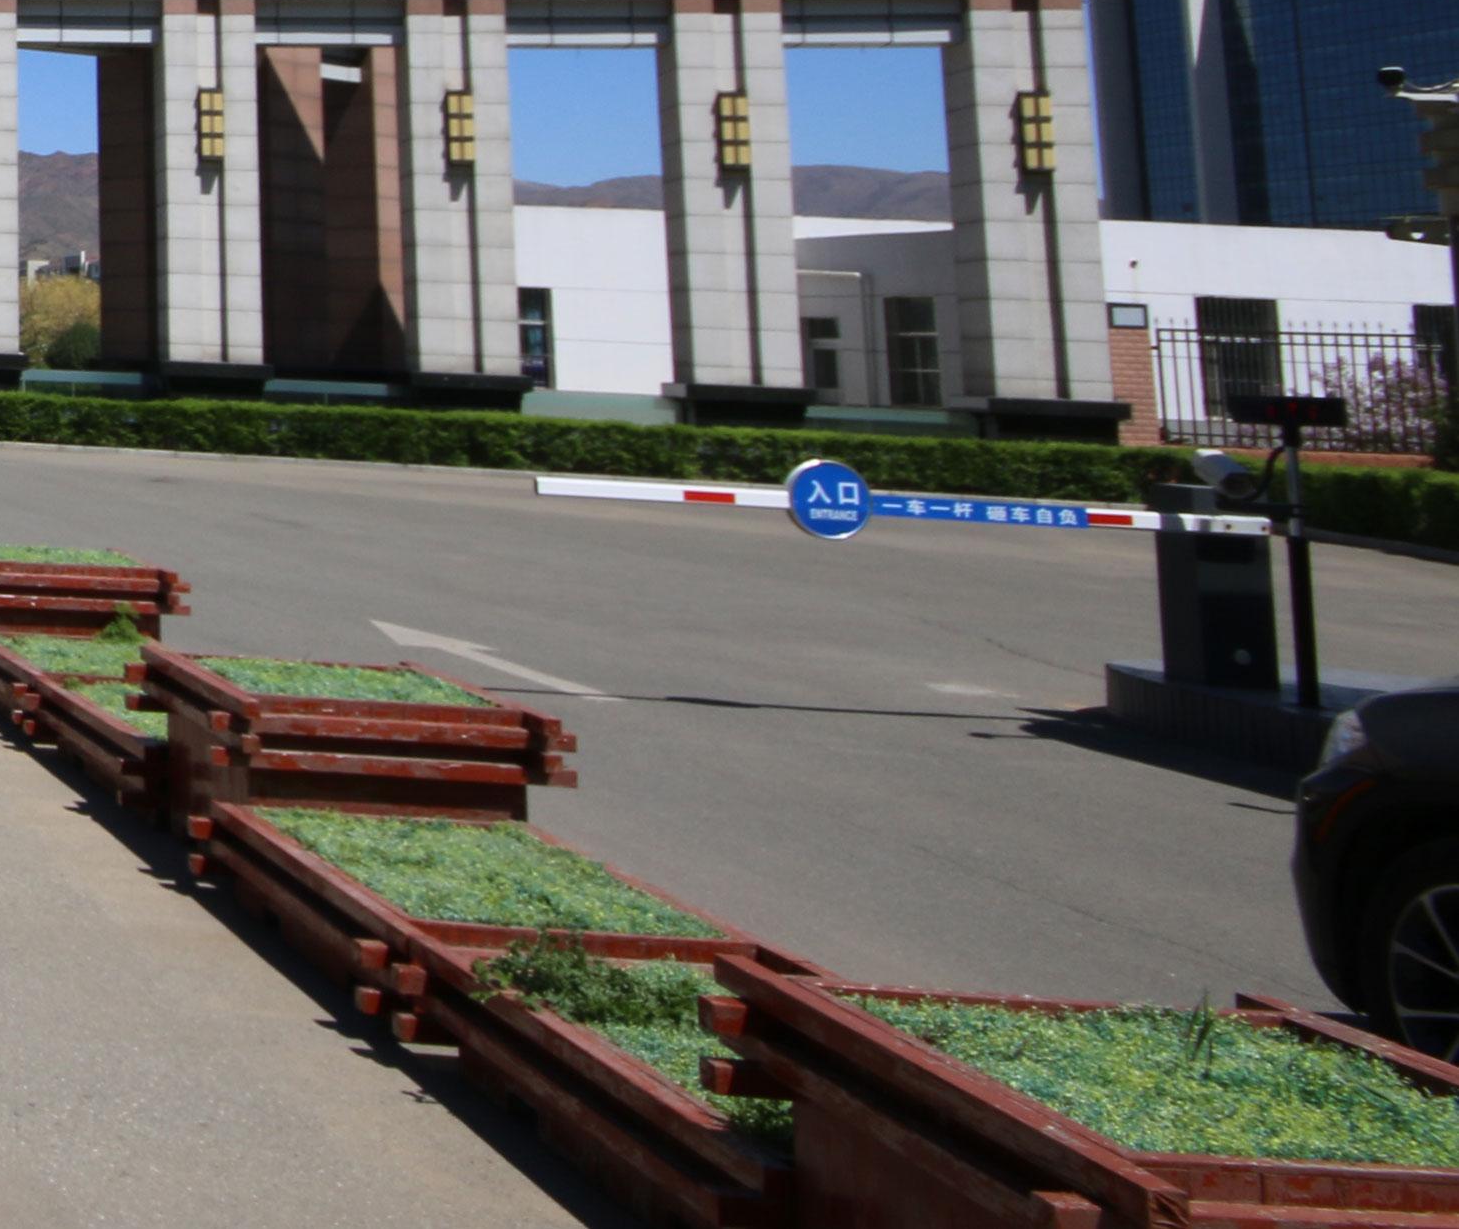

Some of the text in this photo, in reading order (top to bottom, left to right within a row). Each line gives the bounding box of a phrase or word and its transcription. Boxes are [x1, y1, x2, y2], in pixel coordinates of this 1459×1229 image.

[807, 479, 860, 505] 入口
[881, 499, 1079, 526] 一车一杆 砸车自负
